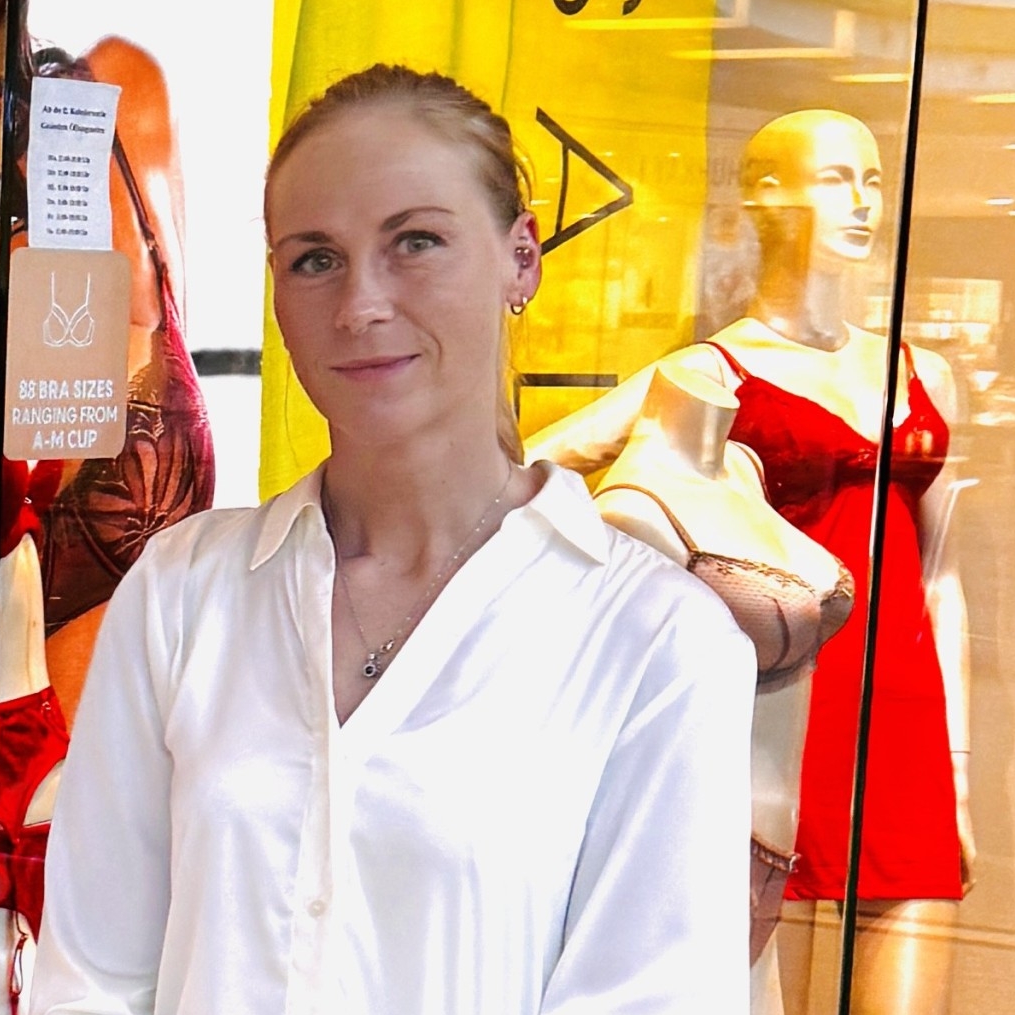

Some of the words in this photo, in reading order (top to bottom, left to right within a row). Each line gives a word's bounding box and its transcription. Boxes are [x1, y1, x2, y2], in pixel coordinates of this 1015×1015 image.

[38, 379, 69, 399] BRA
[73, 379, 114, 399] SIZES
[12, 406, 77, 425] RANGING
[79, 405, 118, 424] FROM
[32, 430, 65, 449] A-M
[67, 429, 98, 449] CUP
